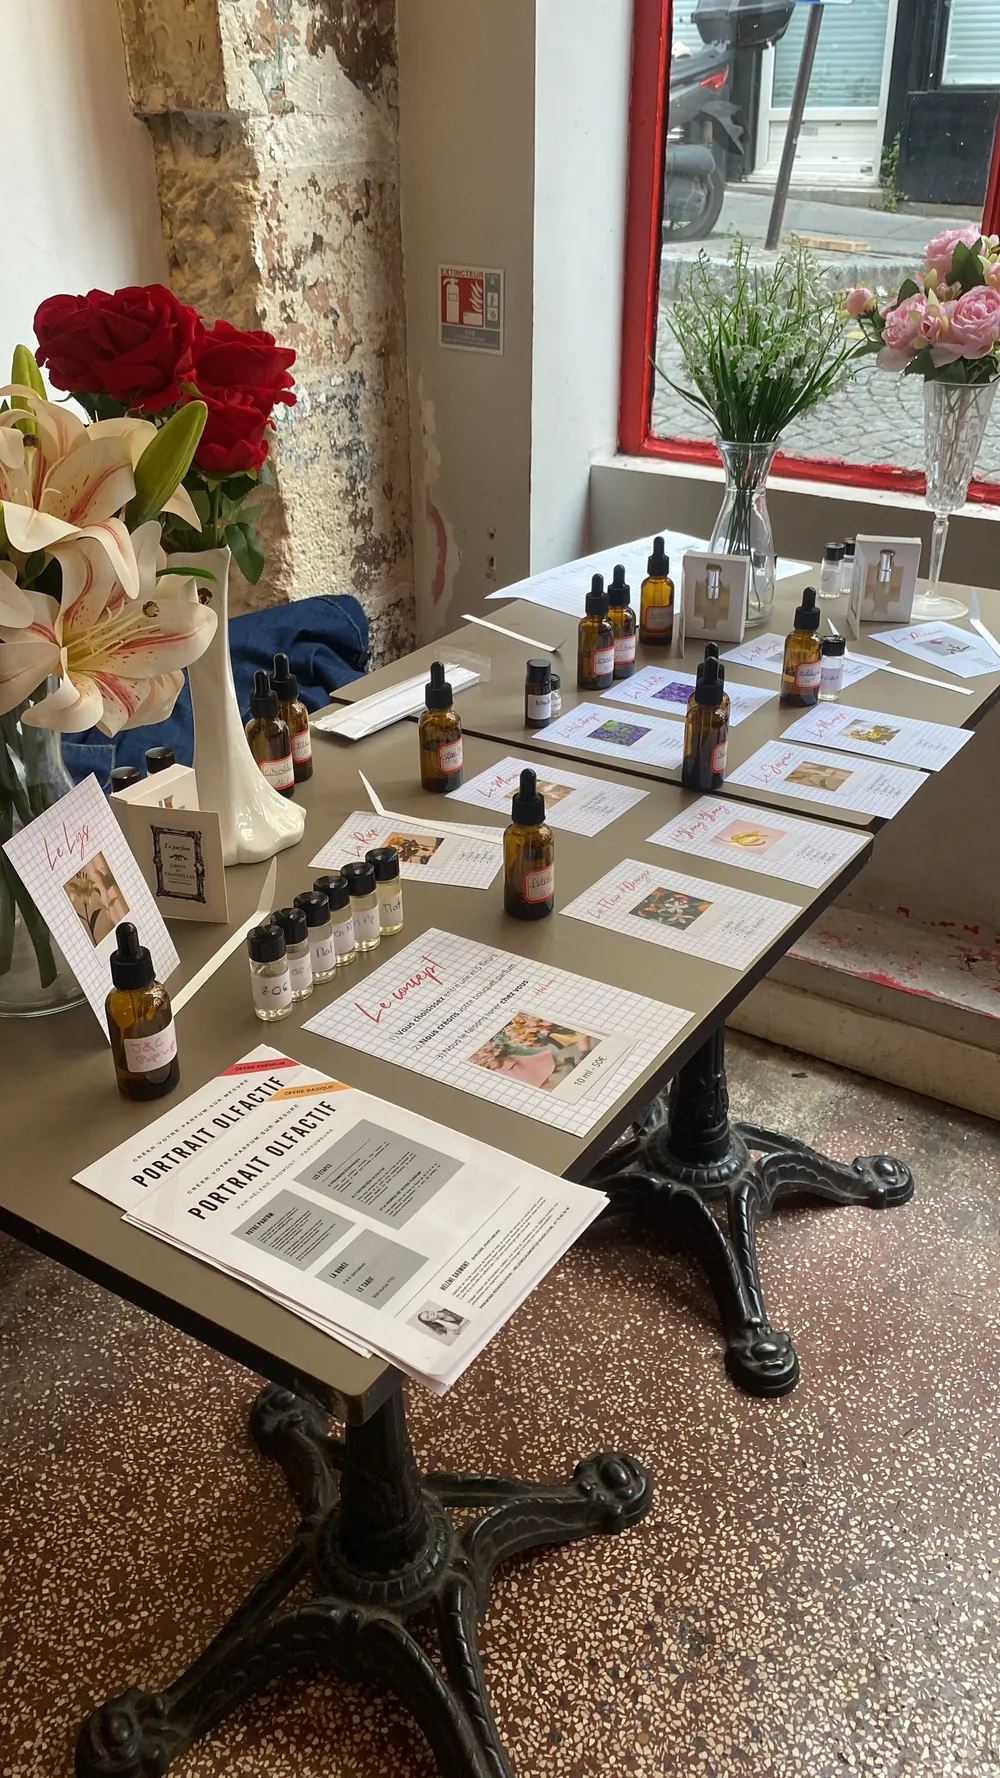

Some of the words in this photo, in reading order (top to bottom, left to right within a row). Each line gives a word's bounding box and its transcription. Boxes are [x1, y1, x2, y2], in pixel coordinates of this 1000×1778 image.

[441, 268, 484, 279] EXTINCTEUR
[751, 772, 770, 784] Le
[44, 837, 63, 871] Le
[62, 820, 90, 861] Lys
[354, 1000, 392, 1023] Le
[392, 951, 448, 1002] concept
[395, 1022, 415, 1035] Vous
[413, 997, 445, 1022] choisissez
[440, 982, 461, 997] entre
[456, 975, 472, 984] une
[478, 952, 498, 966] fleurs
[419, 1030, 439, 1044] Nous
[437, 1012, 460, 1030] créons
[457, 999, 475, 1012] votre
[470, 980, 499, 1000] bouquet
[495, 964, 517, 981] parfum
[442, 1039, 462, 1053] Nous
[464, 1016, 488, 1034] faisons
[484, 1003, 501, 1016] livrer
[500, 992, 515, 1004] chez
[513, 980, 529, 992] vous
[235, 1064, 255, 1073] OFFRE
[256, 1060, 286, 1070] PREMIUM
[284, 1088, 305, 1096] OFFRE
[307, 1084, 335, 1093] BASIQUE
[574, 1078, 585, 1086] 10
[582, 1069, 593, 1079] ml
[591, 1056, 607, 1067] 50€
[131, 1127, 216, 1188] PORTRAIT
[212, 1076, 285, 1129] OLFACTIF
[132, 1144, 156, 1163] CRÉER
[157, 1129, 180, 1146] VOTRE
[181, 1108, 208, 1128] PARFUM
[209, 1098, 223, 1109] SUR
[223, 1078, 249, 1098] MESURE
[187, 1177, 210, 1194] CRÉER
[211, 1158, 233, 1175] VOTRE
[234, 1136, 259, 1156] PARFUM
[260, 1125, 273, 1135] SUR
[274, 1104, 298, 1123] MESURE
[187, 1156, 270, 1220] PORTRAIT
[265, 1101, 336, 1156] OLFACTIF
[236, 1200, 249, 1209] PAR
[271, 1160, 296, 1181] GAUMONT
[300, 1129, 333, 1156] PARFUMEURE
[317, 1164, 332, 1175] ÉTAPES
[245, 1224, 260, 1235] VOTRE
[257, 1212, 274, 1226] PARFUM
[361, 1276, 374, 1288] TARIF
[440, 1277, 455, 1291] HÉLÈNE
[452, 1260, 470, 1278] GAUMONT
